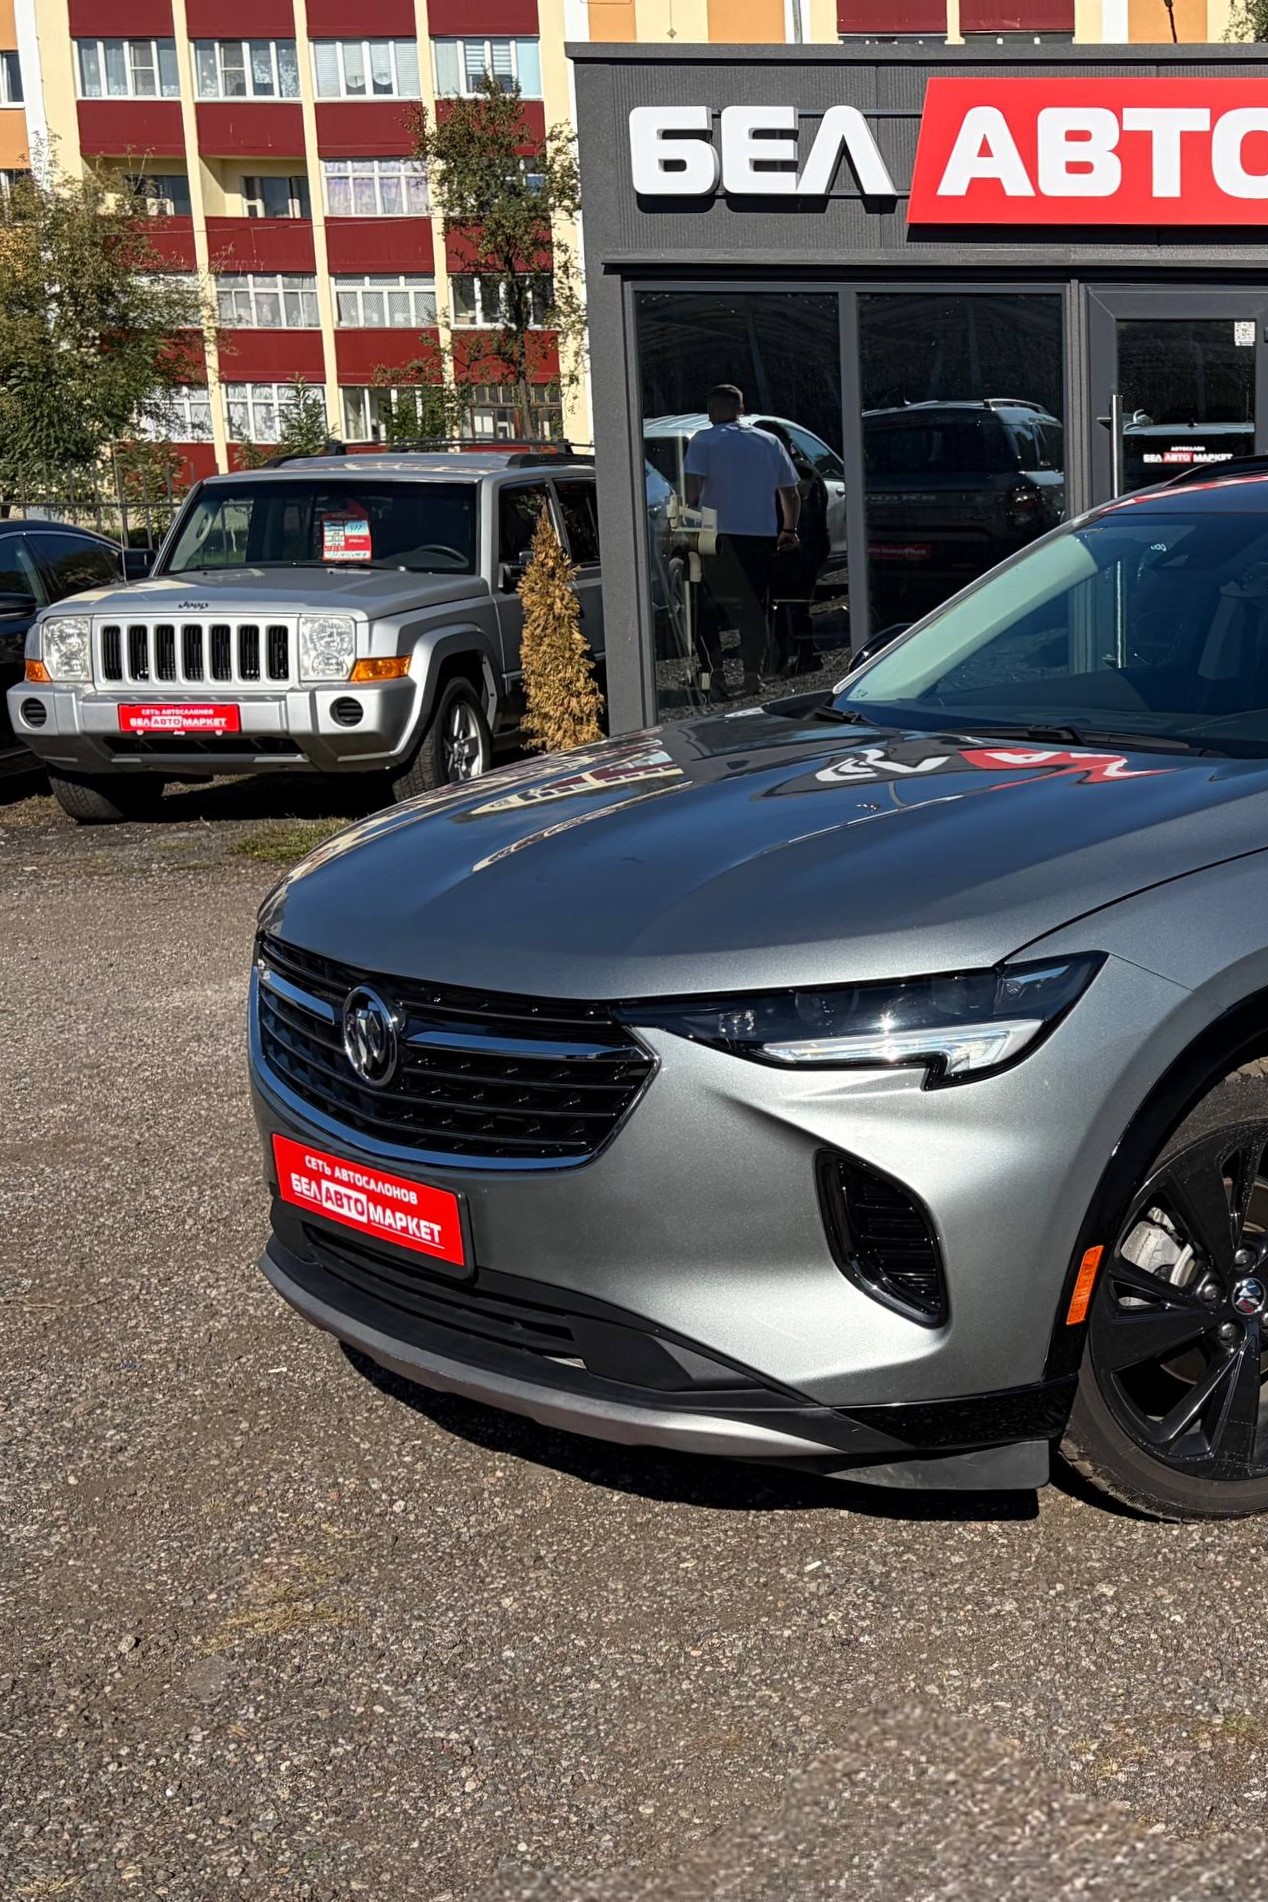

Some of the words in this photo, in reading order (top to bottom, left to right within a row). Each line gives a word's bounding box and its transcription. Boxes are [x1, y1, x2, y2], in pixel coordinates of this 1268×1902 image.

[629, 104, 897, 196] БЕЛ
[1143, 454, 1162, 463] БЕЛ
[1164, 453, 1191, 462] АВТО
[1193, 453, 1233, 463] МАРКЕТ
[178, 600, 209, 610] Jeep
[130, 717, 150, 727] БЕЛ
[153, 718, 181, 726] АВТО
[182, 717, 228, 728] МАРКЕТ
[304, 1154, 332, 1176] СЕТЬ
[334, 1166, 418, 1206] АВТОСАЛОНОВ
[290, 1172, 322, 1201] БЕЛ
[324, 1183, 366, 1217] АВТО
[369, 1202, 442, 1244] МАРКЕТ
